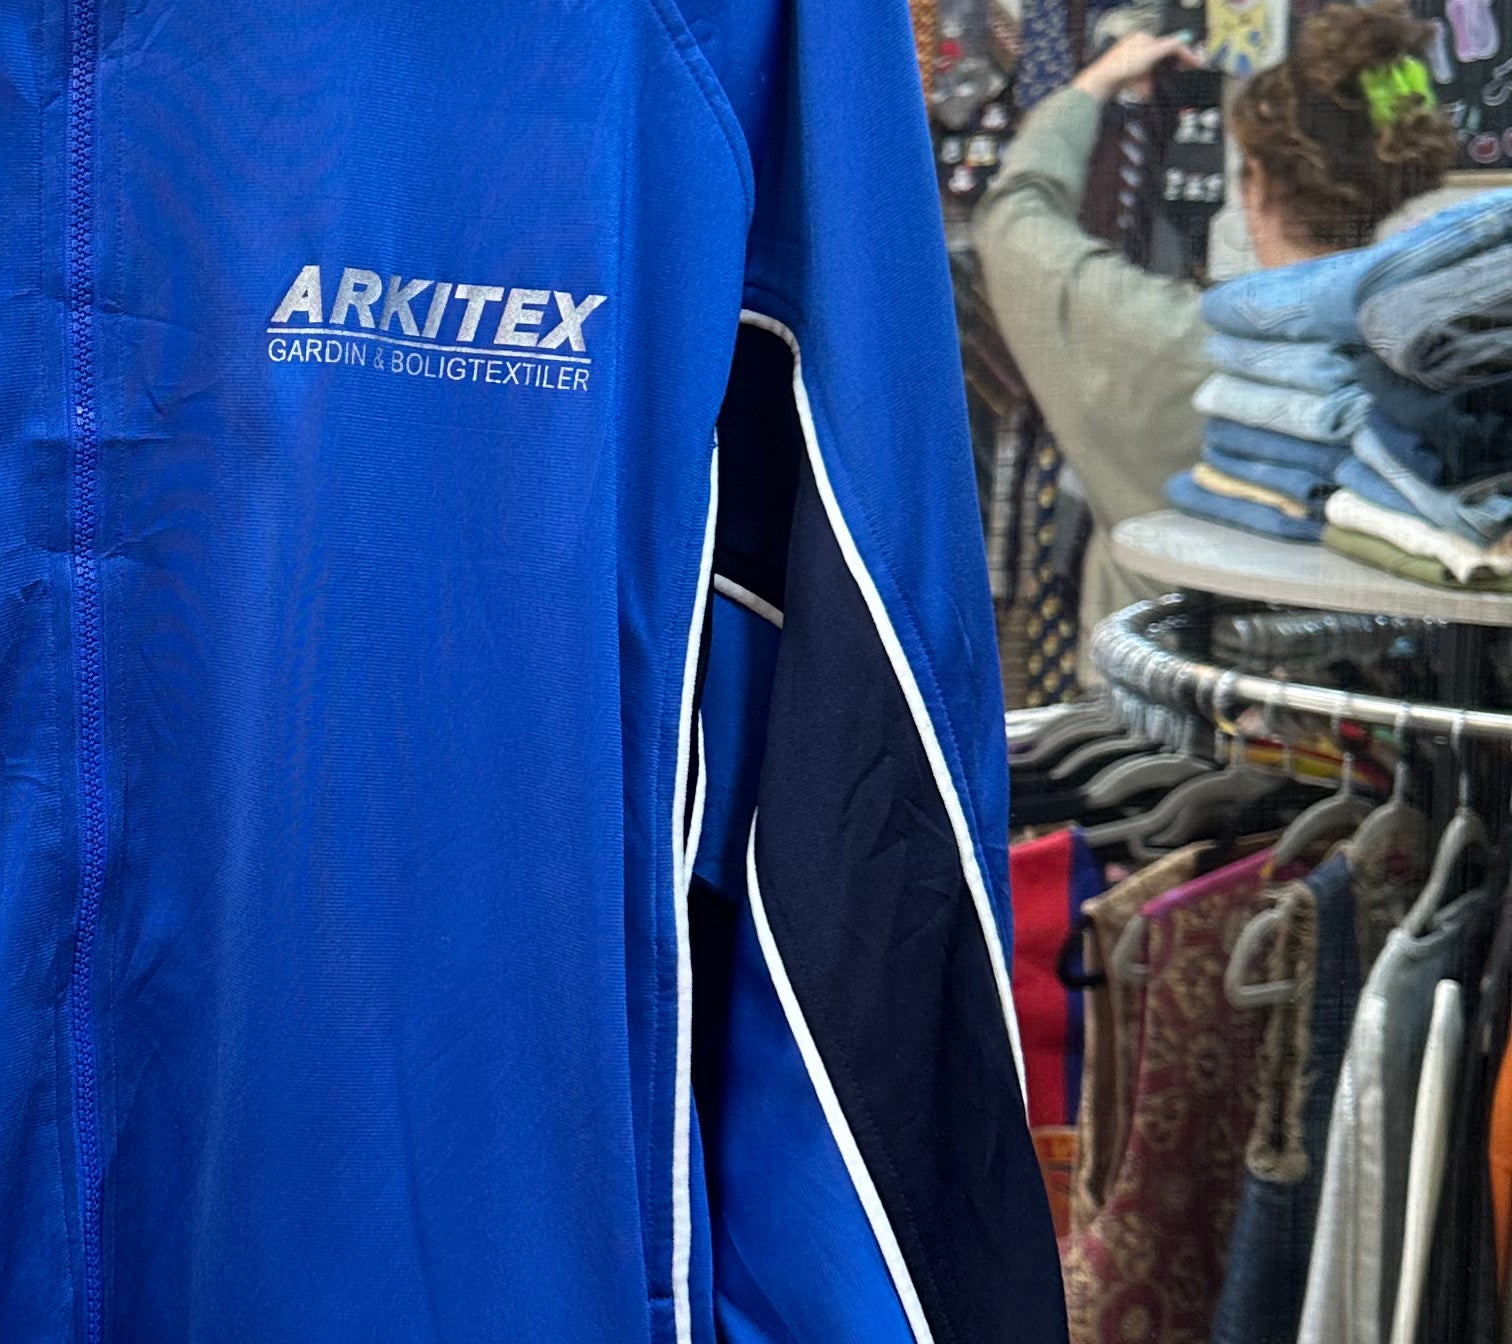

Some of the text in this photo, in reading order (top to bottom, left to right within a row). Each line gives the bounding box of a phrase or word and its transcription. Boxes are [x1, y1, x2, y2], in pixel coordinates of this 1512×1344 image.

[270, 265, 607, 352] ARKITEX
[268, 338, 590, 392] GARDIN & BOLIGTEXTILER
